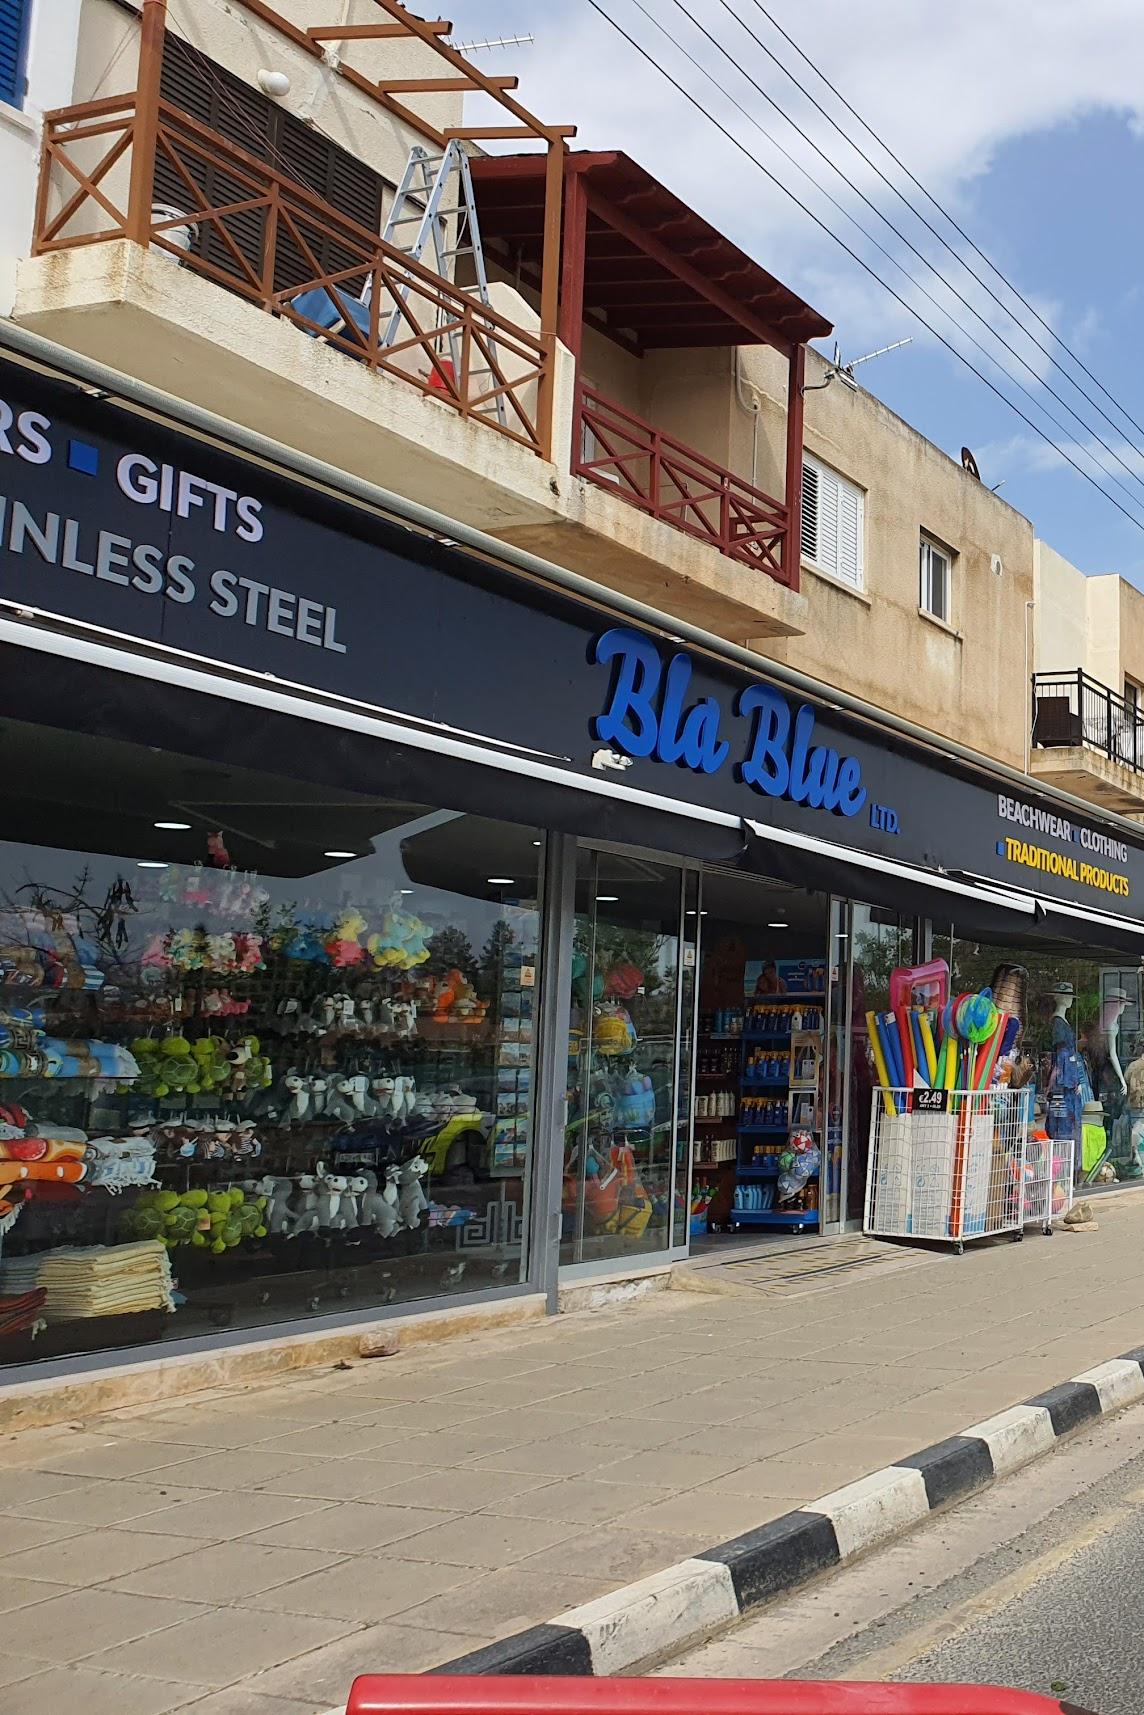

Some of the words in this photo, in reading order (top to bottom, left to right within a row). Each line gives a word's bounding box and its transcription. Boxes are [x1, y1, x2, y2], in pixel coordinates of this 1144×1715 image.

[117, 454, 264, 542] GIFTS
[209, 570, 347, 654] STEEL
[592, 627, 731, 775] Bla
[737, 683, 868, 818] Blue
[998, 794, 1072, 842] BEACHWEAR
[1080, 827, 1128, 863] CLOTHING
[1005, 836, 1080, 881] TRADITIONAL
[1080, 862, 1129, 897] PRODUCTS
[918, 1091, 942, 1104] €2.49
